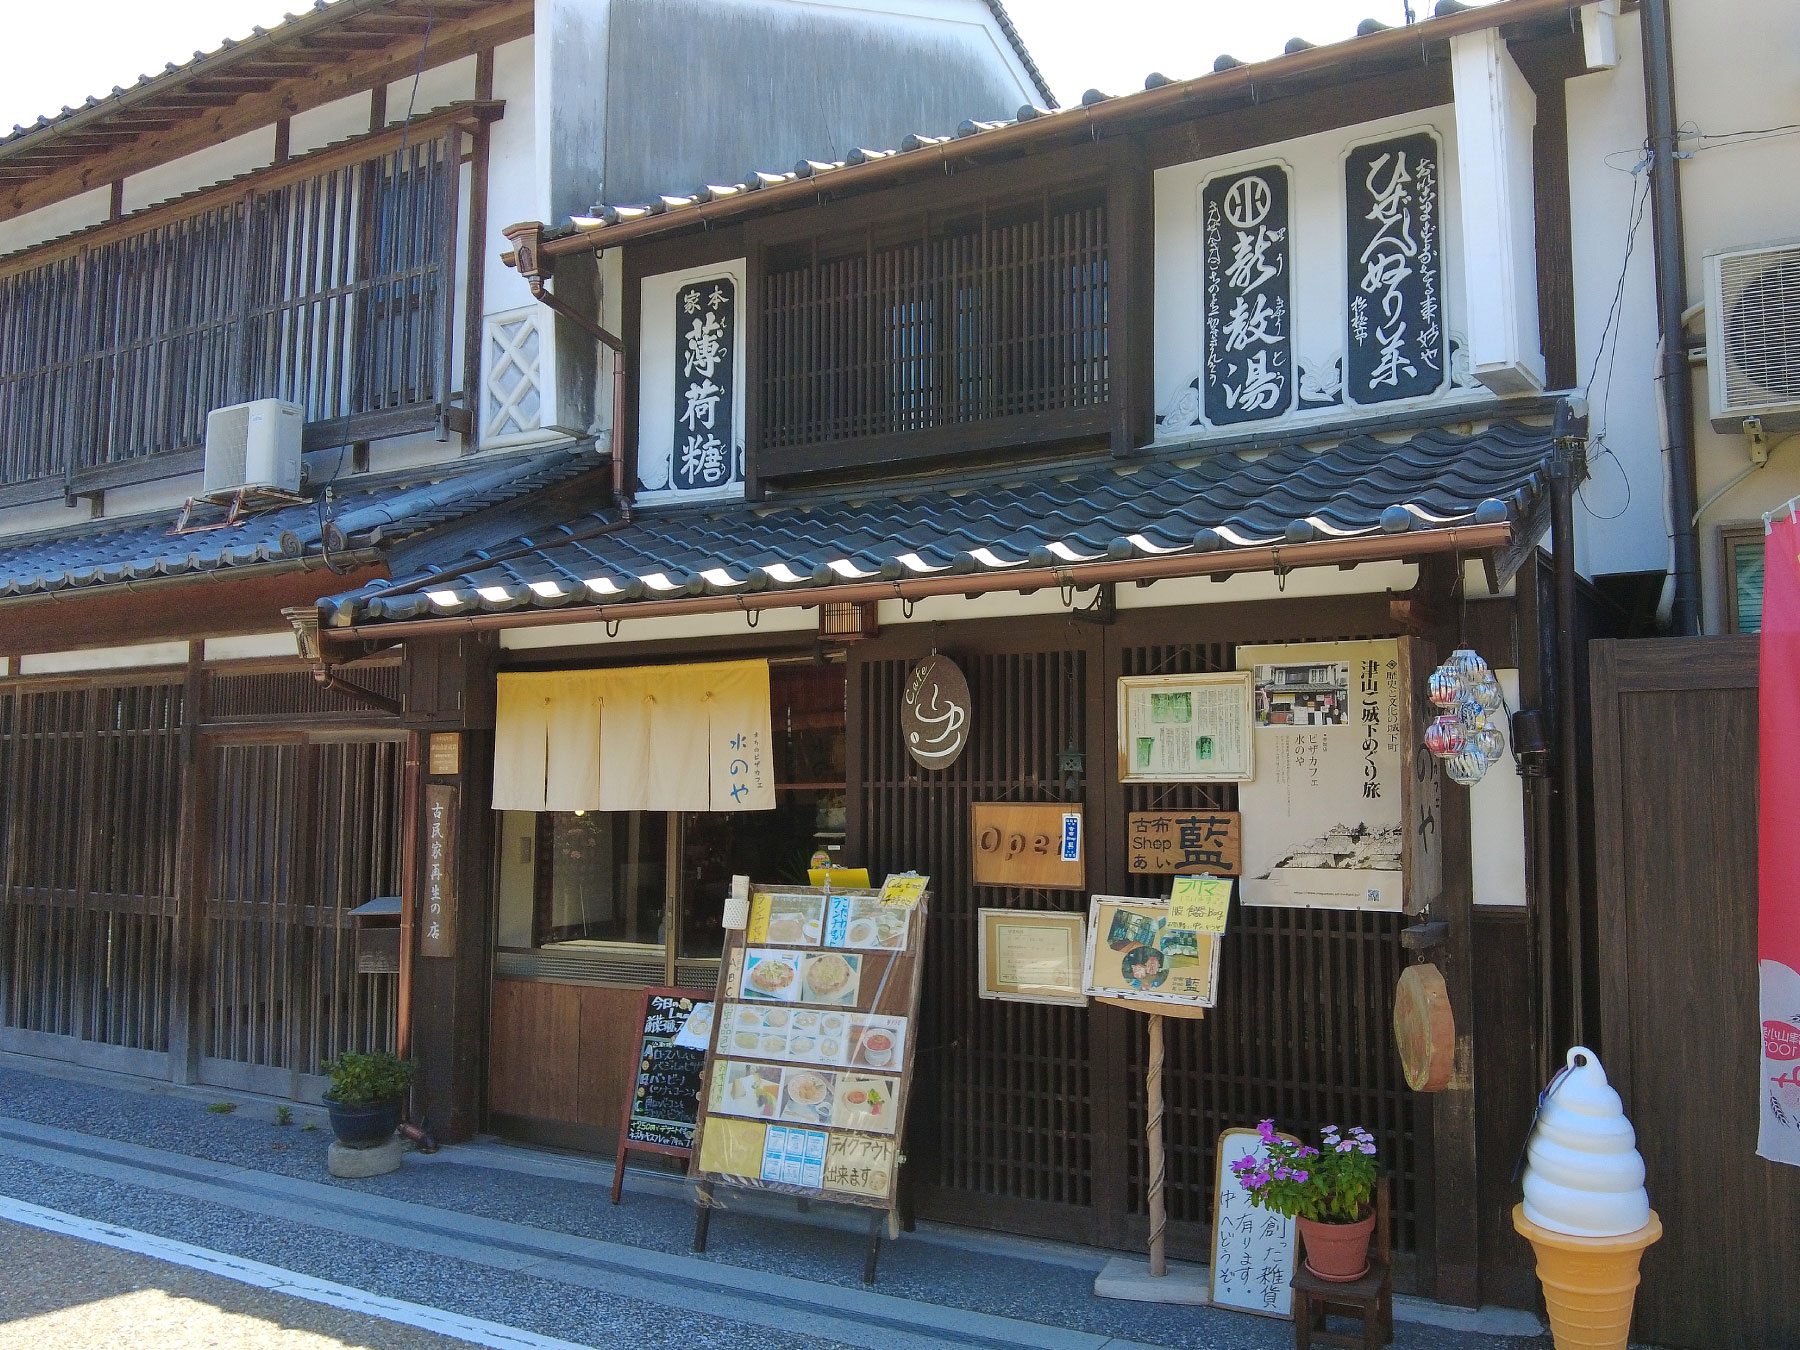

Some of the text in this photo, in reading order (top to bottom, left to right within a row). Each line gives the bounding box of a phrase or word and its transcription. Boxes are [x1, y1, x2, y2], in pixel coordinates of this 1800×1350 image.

[684, 285, 729, 315] 本家
[680, 311, 723, 485] 薄荷糖
[905, 664, 928, 705] Cafe
[1360, 660, 1381, 798] 津山ご城下めぐり旅
[1386, 671, 1400, 753] 歴史と文化の城下町
[730, 732, 749, 804] 水のや
[1295, 734, 1305, 766] 水のや
[1308, 734, 1319, 787] ピザカフェ
[1132, 816, 1173, 833] 古布
[1132, 836, 1172, 852] Shop
[1174, 815, 1234, 871] 藍
[427, 802, 443, 940] 古民家再生の店
[1133, 854, 1171, 870] あい
[1177, 880, 1220, 897] フリマ
[831, 1136, 892, 1161] テイクアウト
[826, 1164, 872, 1187] 出来ます
